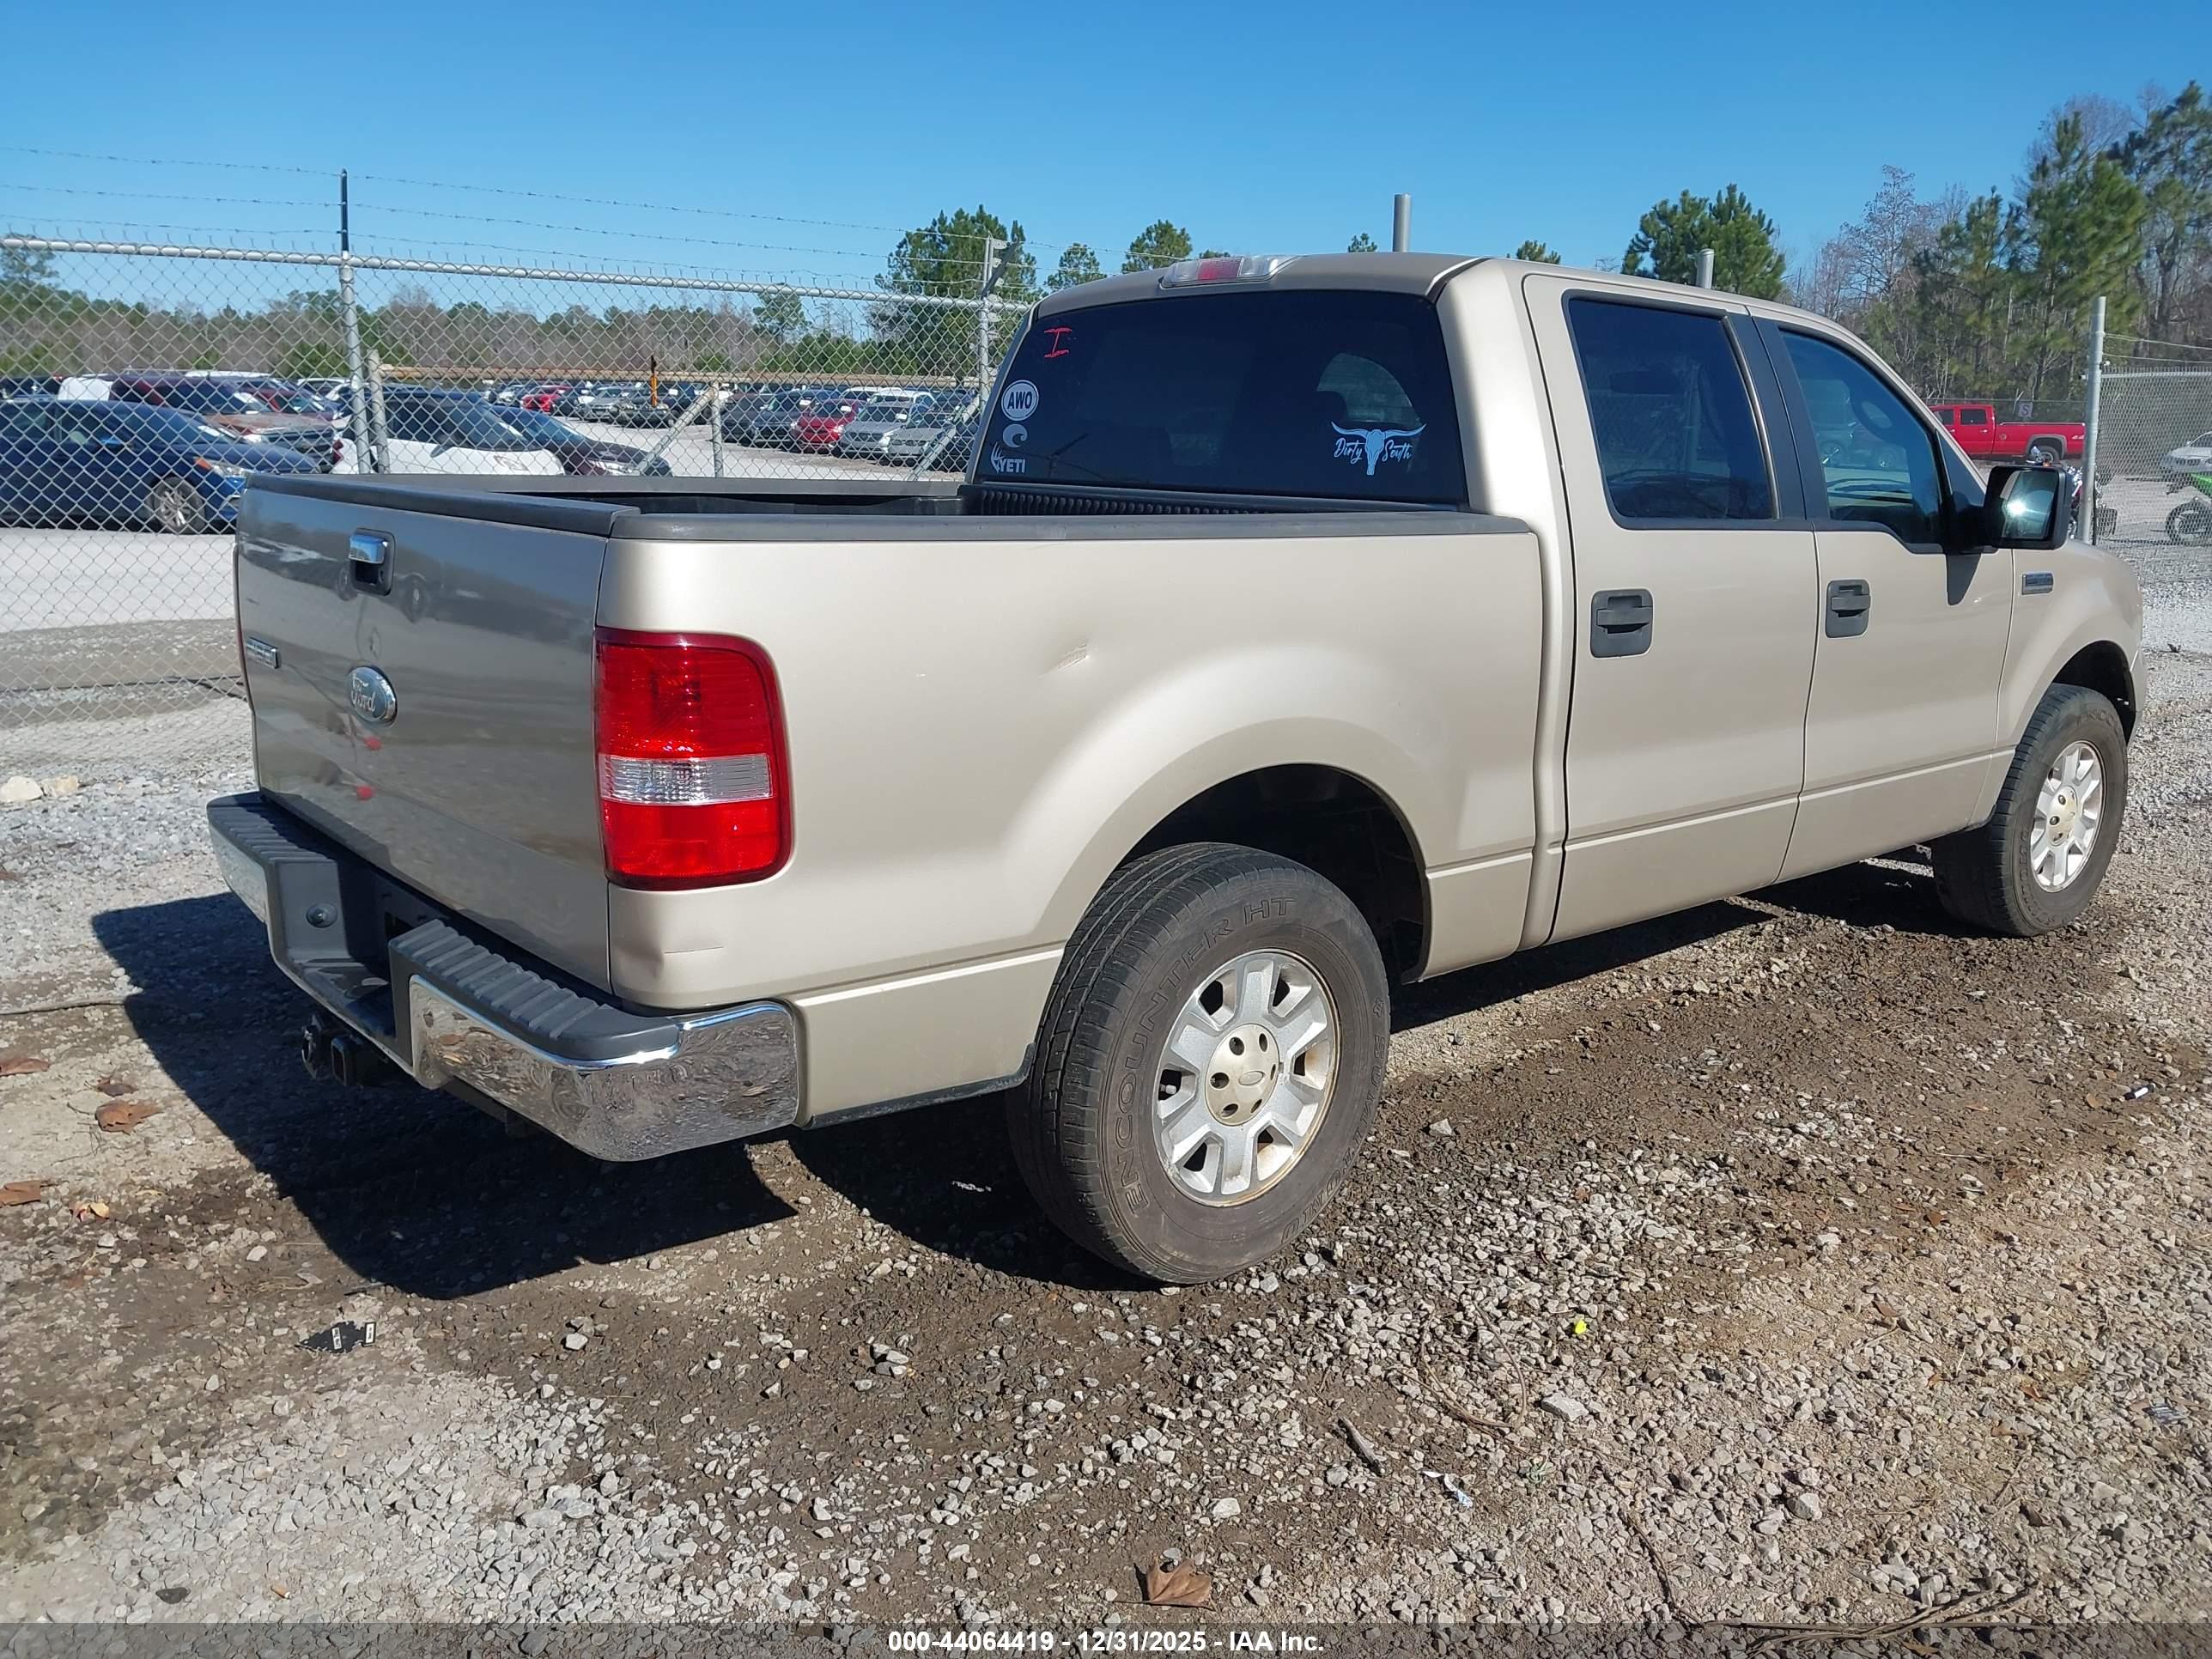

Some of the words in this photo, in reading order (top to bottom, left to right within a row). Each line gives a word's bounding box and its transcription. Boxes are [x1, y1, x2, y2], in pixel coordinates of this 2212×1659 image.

[1007, 391, 1032, 410] AWO
[1334, 437, 1366, 464] Dirty
[1382, 439, 1413, 462] South
[1000, 459, 1026, 472] YETI
[350, 673, 376, 713] Ford
[1115, 918, 1233, 1216] ENCOUNTER
[1244, 896, 1297, 926] HT
